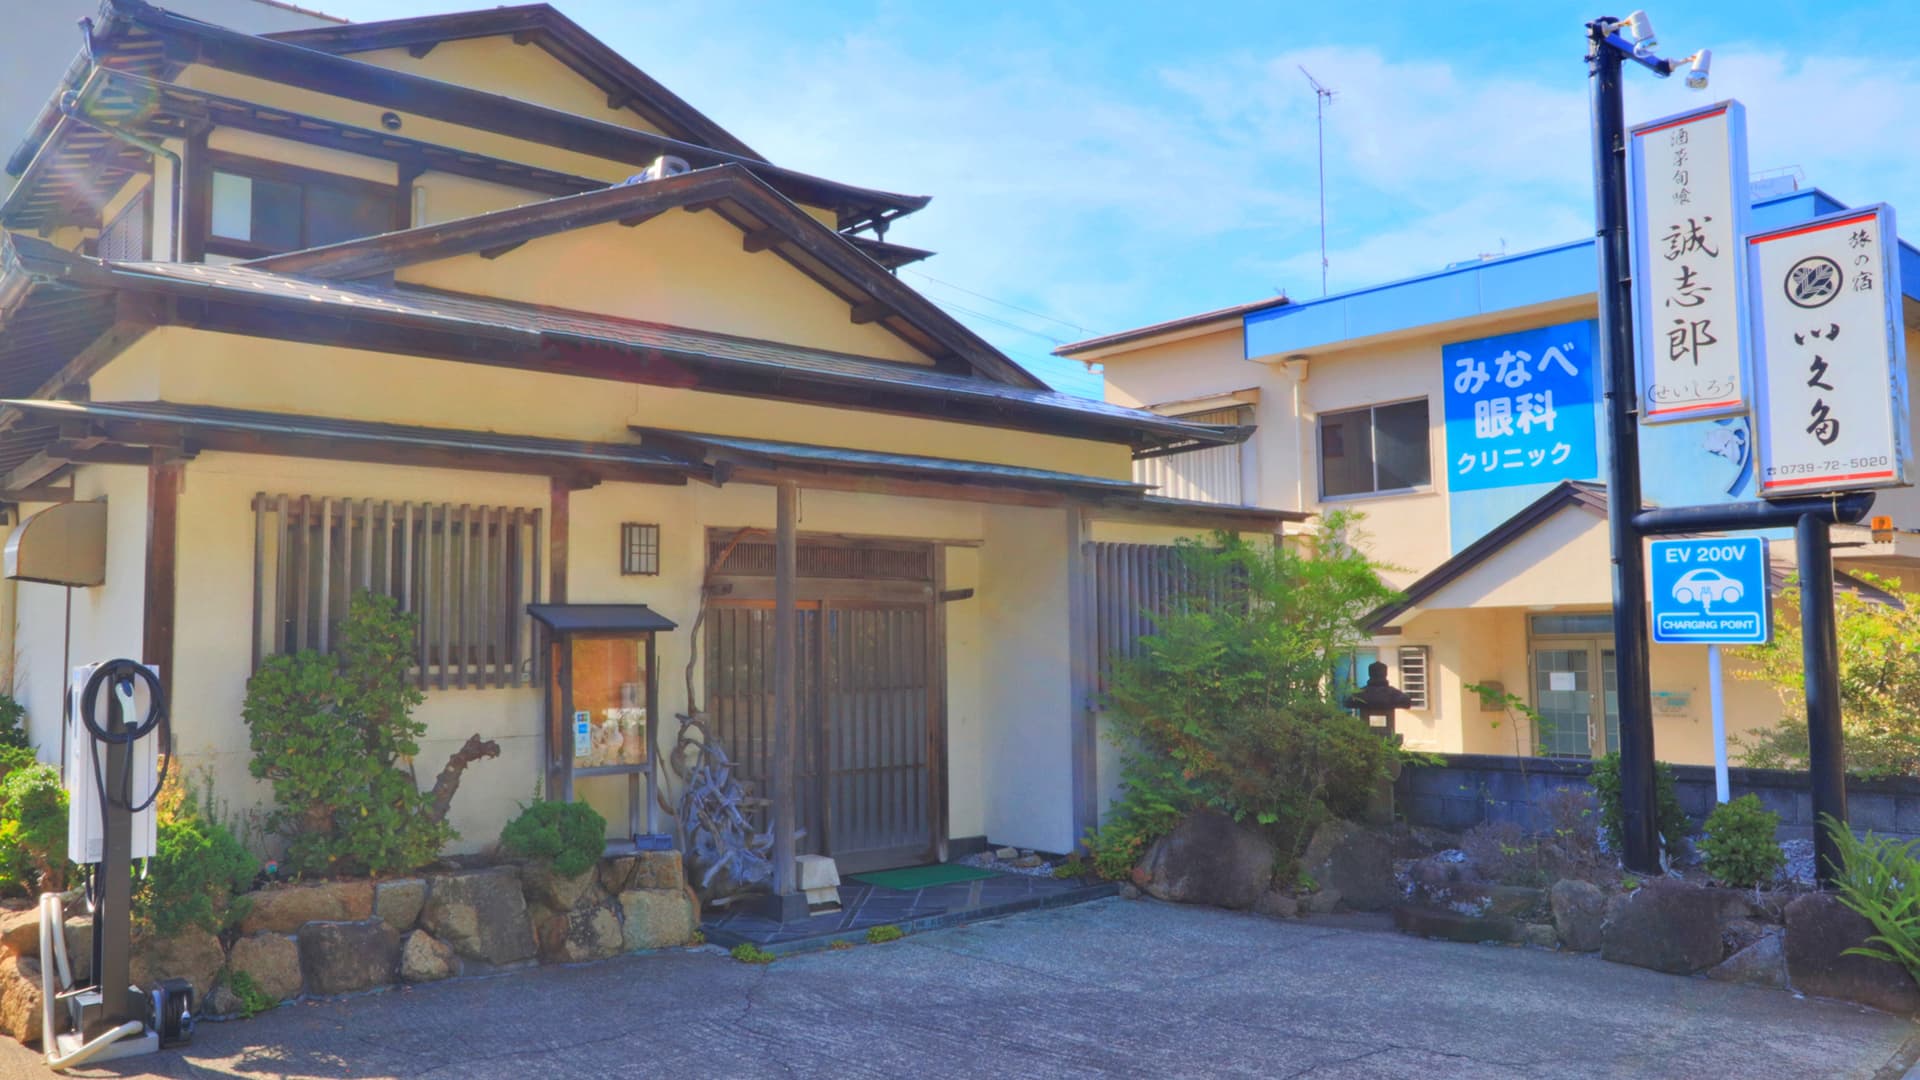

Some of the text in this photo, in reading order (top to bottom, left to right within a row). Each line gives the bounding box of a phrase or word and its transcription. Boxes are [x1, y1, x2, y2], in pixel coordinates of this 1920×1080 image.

[1848, 228, 1873, 292] 旅の宿
[1661, 215, 1720, 366] 誠志郎
[1453, 341, 1579, 395] みなべ
[1474, 389, 1557, 439] 眼科
[1457, 441, 1571, 475] クリニック
[1780, 455, 1888, 475] 0739-72-5020
[1665, 545, 1746, 563] EV 200V
[1662, 620, 1754, 630] CHARGING POINT
